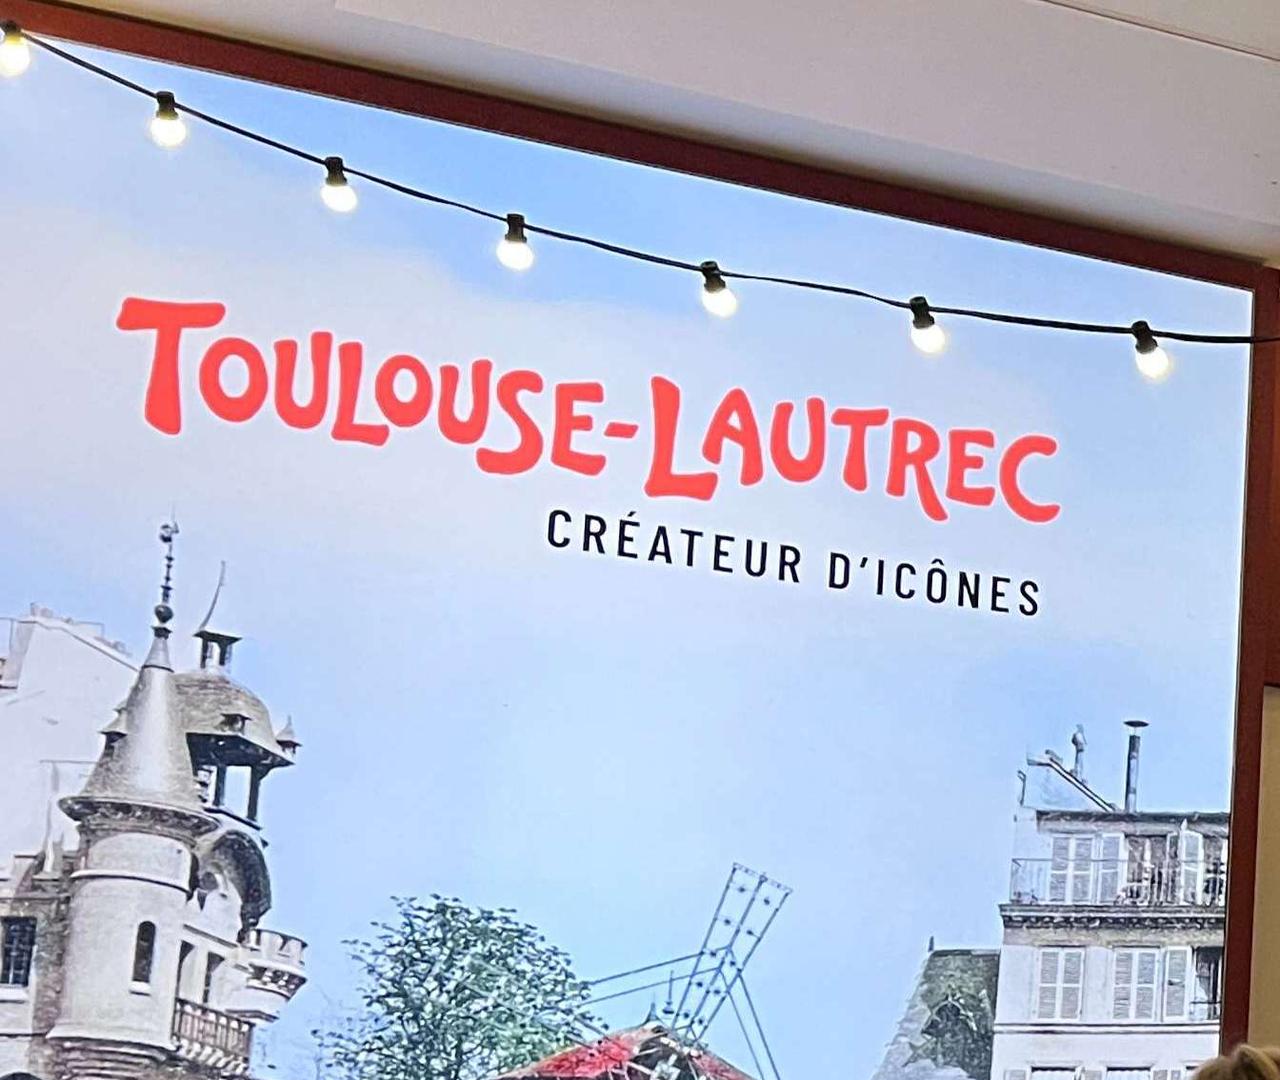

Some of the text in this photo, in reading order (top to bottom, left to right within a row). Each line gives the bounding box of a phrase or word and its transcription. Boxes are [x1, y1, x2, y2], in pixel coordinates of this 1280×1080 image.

[116, 295, 1062, 524] TOULOUSE-LAUTREC
[546, 510, 1041, 617] CRÉATEUR D'ICÔNES
